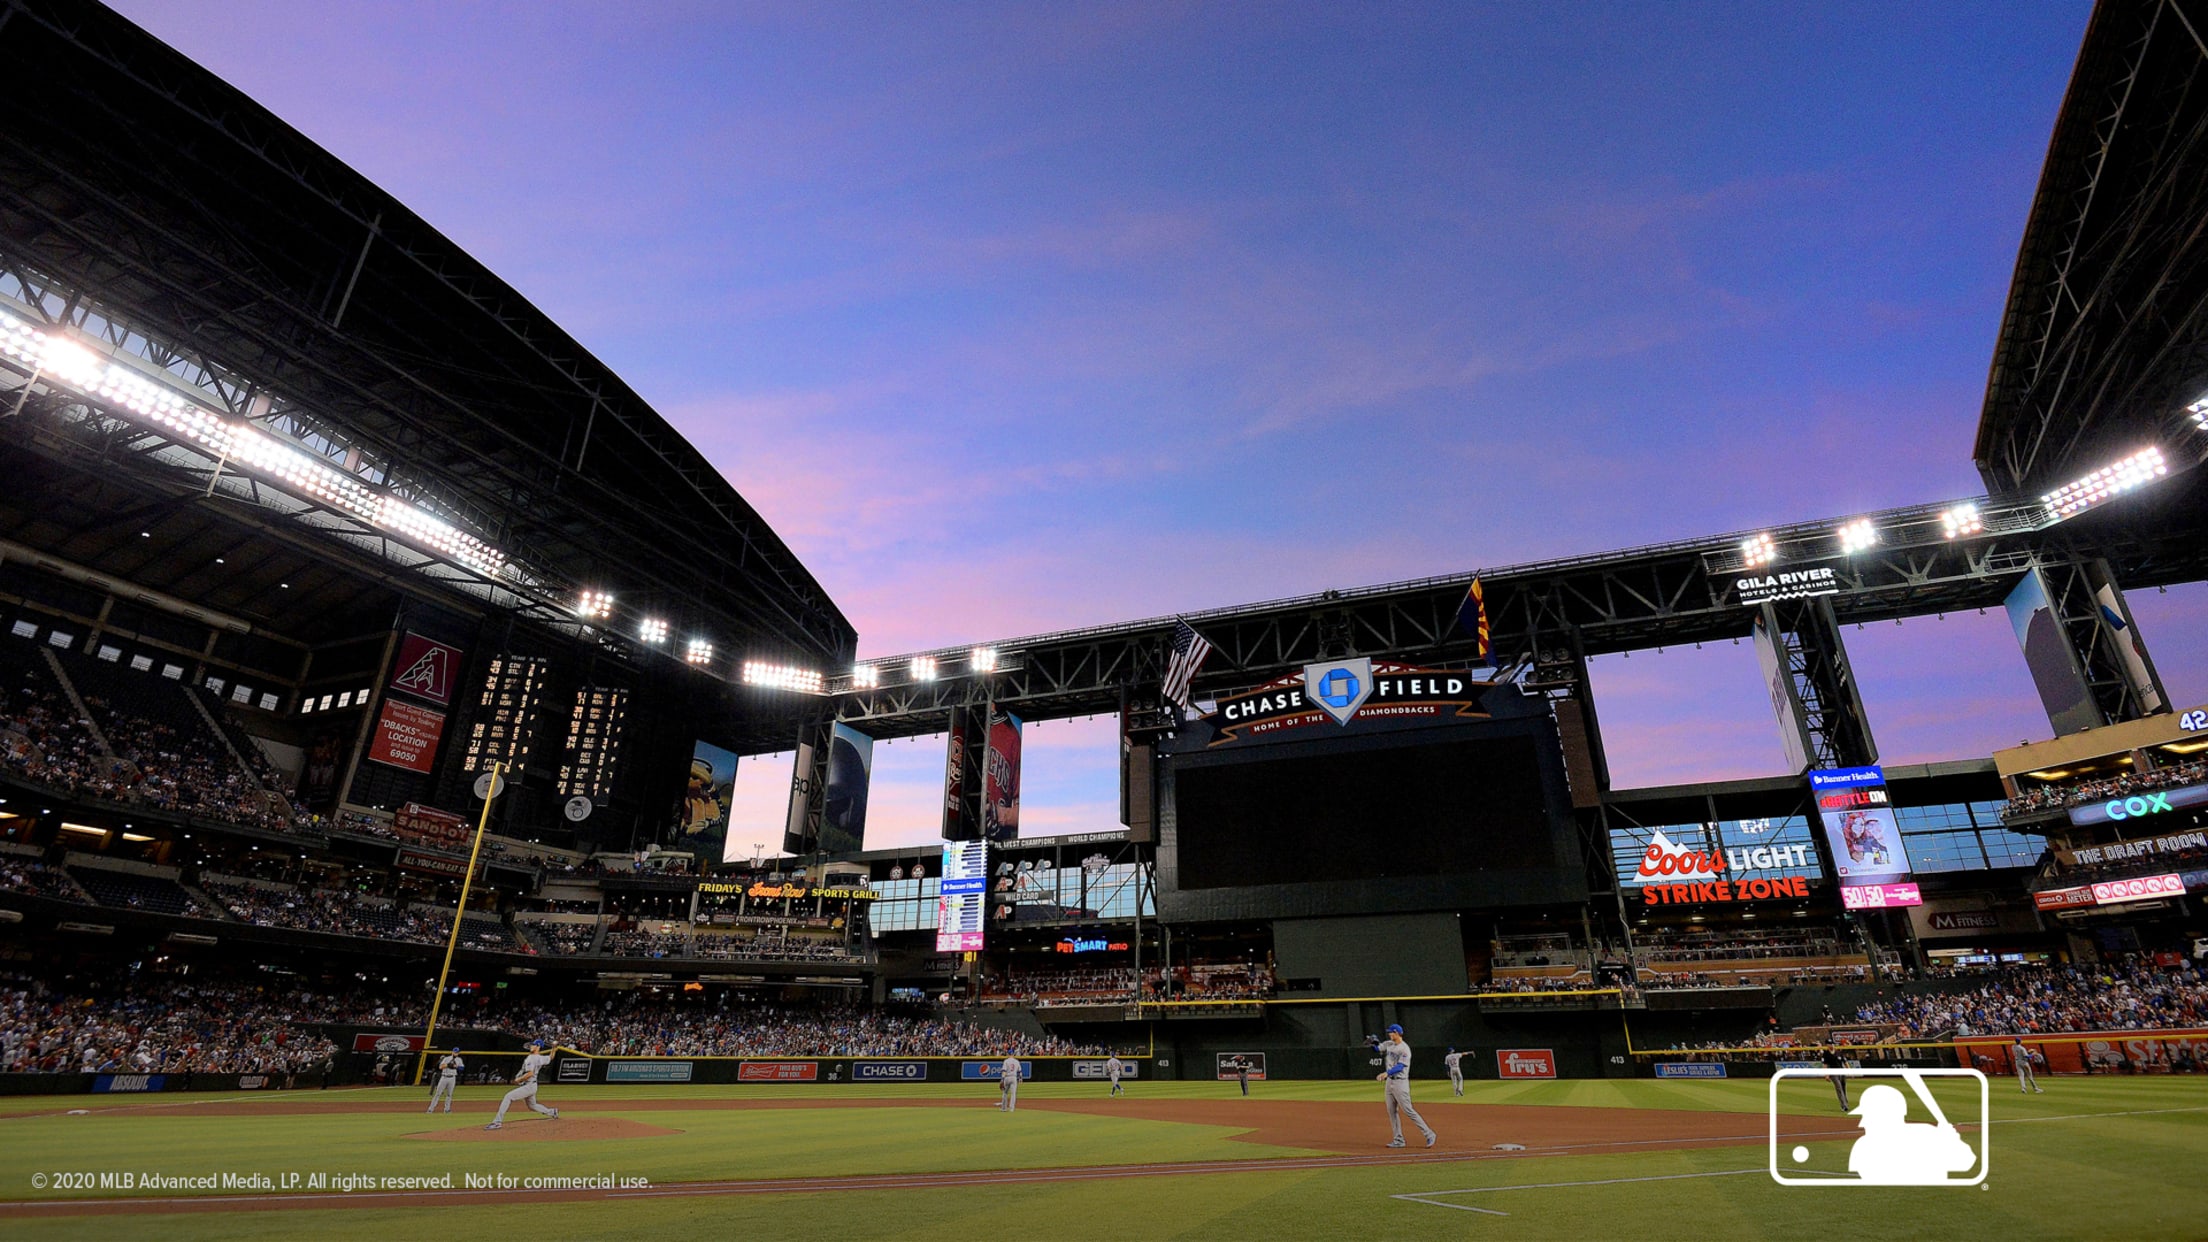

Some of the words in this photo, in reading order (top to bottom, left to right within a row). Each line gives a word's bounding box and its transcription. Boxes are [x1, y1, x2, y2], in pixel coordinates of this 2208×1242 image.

[1737, 576, 1778, 590] GILA
[1779, 568, 1833, 584] RIVER
[1740, 588, 1778, 598] HOTELS
[1792, 580, 1836, 590] CASINOS
[1225, 691, 1302, 720] CHASE
[1380, 679, 1463, 696] FIELD
[1360, 706, 1435, 716] DIAMONDBACKS
[1254, 722, 1280, 732] HOME
[1287, 718, 1300, 726] OF
[1306, 714, 1324, 723] THE
[388, 731, 427, 748] LOCATION
[390, 749, 416, 762] 69050
[1823, 774, 1851, 783] Banner
[2105, 792, 2173, 820] COX
[397, 816, 468, 839] SANDLOT
[1003, 840, 1020, 848] WEST
[1021, 837, 1056, 847] CHAMPIONS
[1068, 835, 1088, 843] WORLD
[1089, 832, 1125, 842] CHAMPIONS
[2072, 847, 2103, 865] THE
[2104, 840, 2154, 860] DRAFT
[2156, 832, 2208, 852] ROOM
[1638, 844, 1728, 877] Coors
[1726, 844, 1808, 871] LIGHT
[698, 883, 742, 894] FRIDAY'S
[781, 883, 806, 897] Row
[812, 888, 850, 898] SPORTS
[852, 890, 880, 900] GRILL
[1005, 892, 1020, 901] WILD
[1022, 892, 1039, 900] CARD
[1642, 881, 1732, 905] STRIKE
[1735, 876, 1810, 900] ZONE
[2067, 894, 2093, 904] METER
[1956, 916, 1997, 927] FITNESS
[1505, 1053, 1548, 1075] fry's
[1610, 1056, 1625, 1064] 413
[863, 1066, 904, 1076] CHASE
